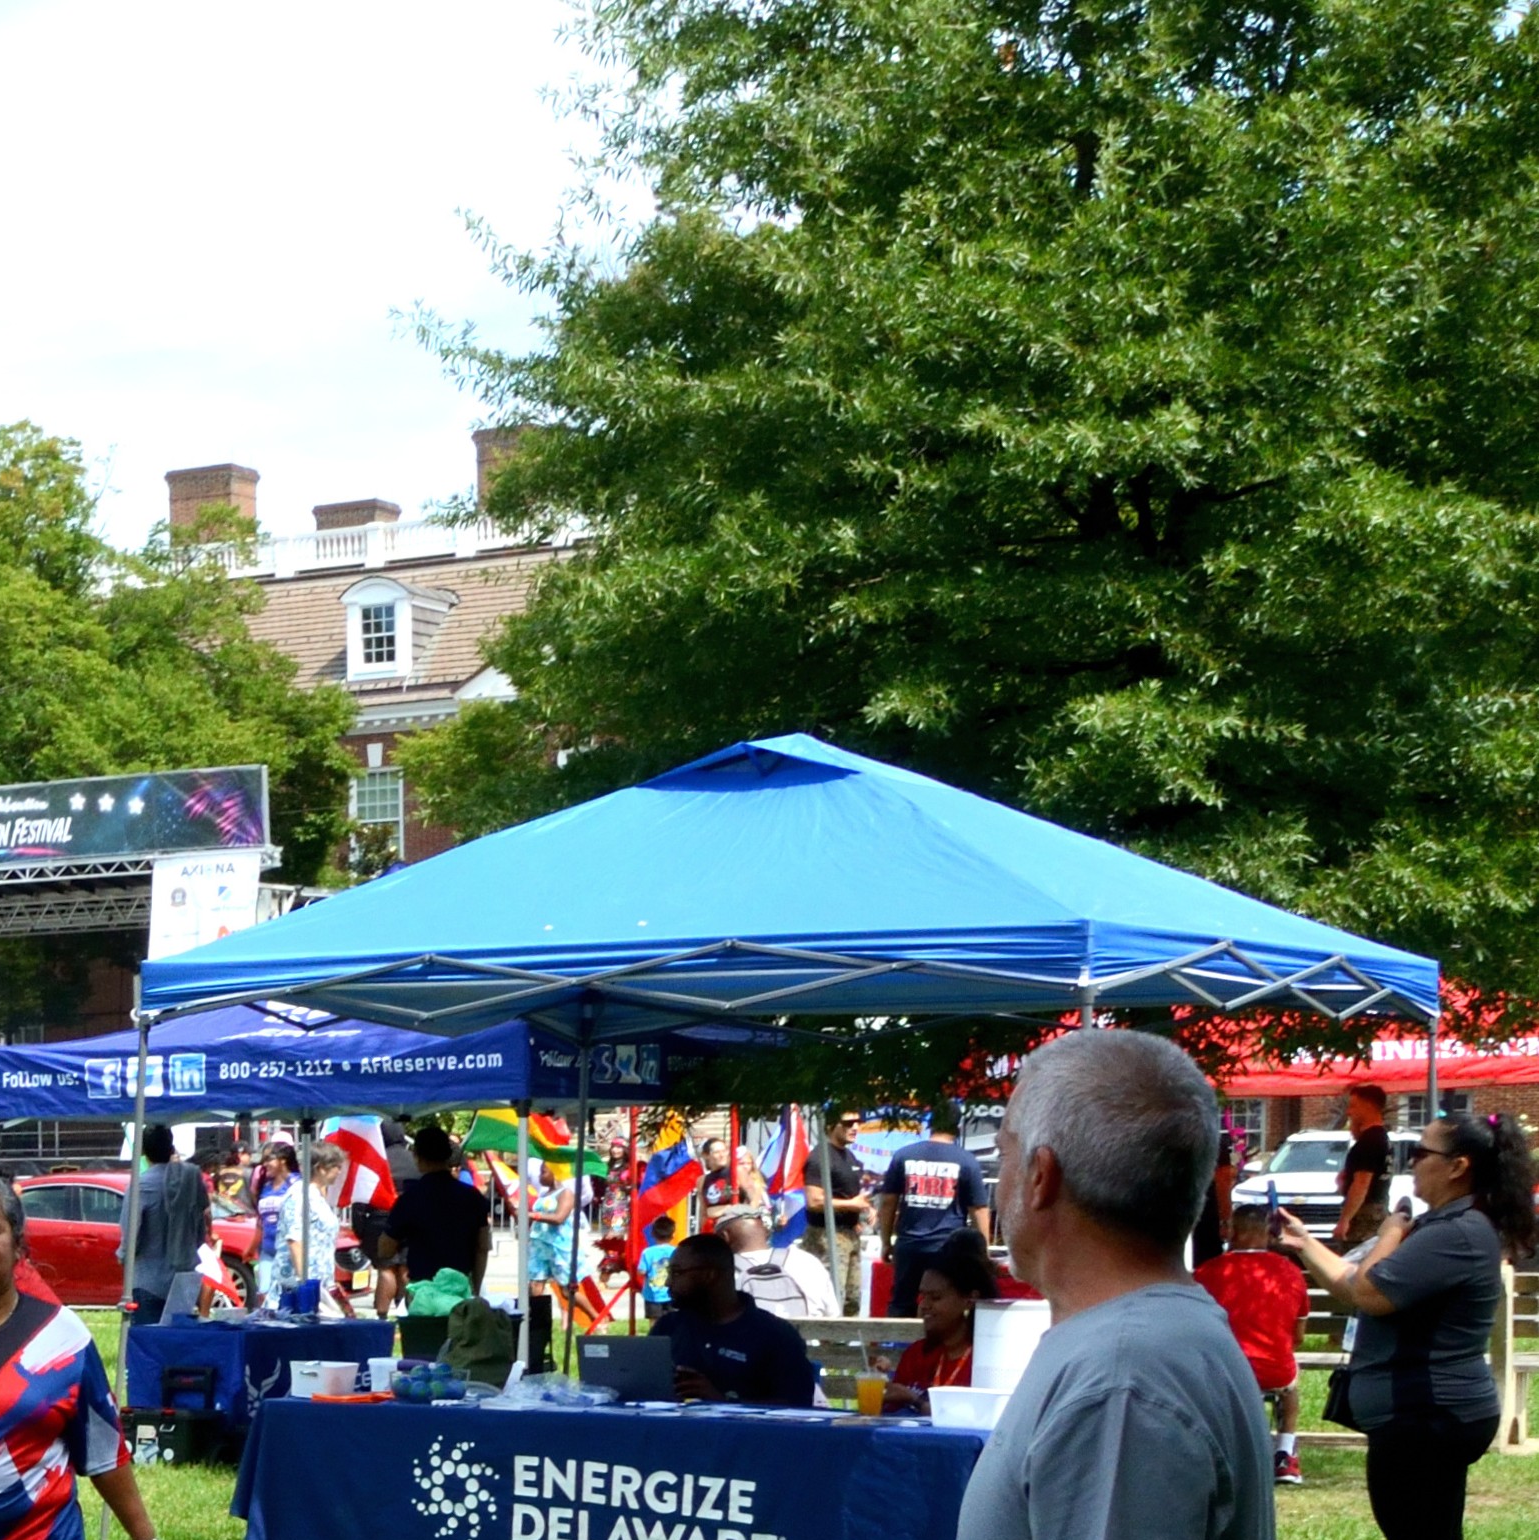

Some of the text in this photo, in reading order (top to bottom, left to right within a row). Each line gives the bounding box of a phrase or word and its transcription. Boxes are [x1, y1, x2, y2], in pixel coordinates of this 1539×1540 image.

[10, 816, 73, 848] FESTIVAL
[2, 1071, 52, 1088] Follow
[56, 1070, 80, 1085] us:
[219, 1059, 334, 1079] 800-257-1212
[359, 1052, 503, 1074] AFReserve.com
[904, 1160, 960, 1179] DOVER
[906, 1175, 957, 1198] FIRE
[513, 1455, 757, 1524] ENERGIZE
